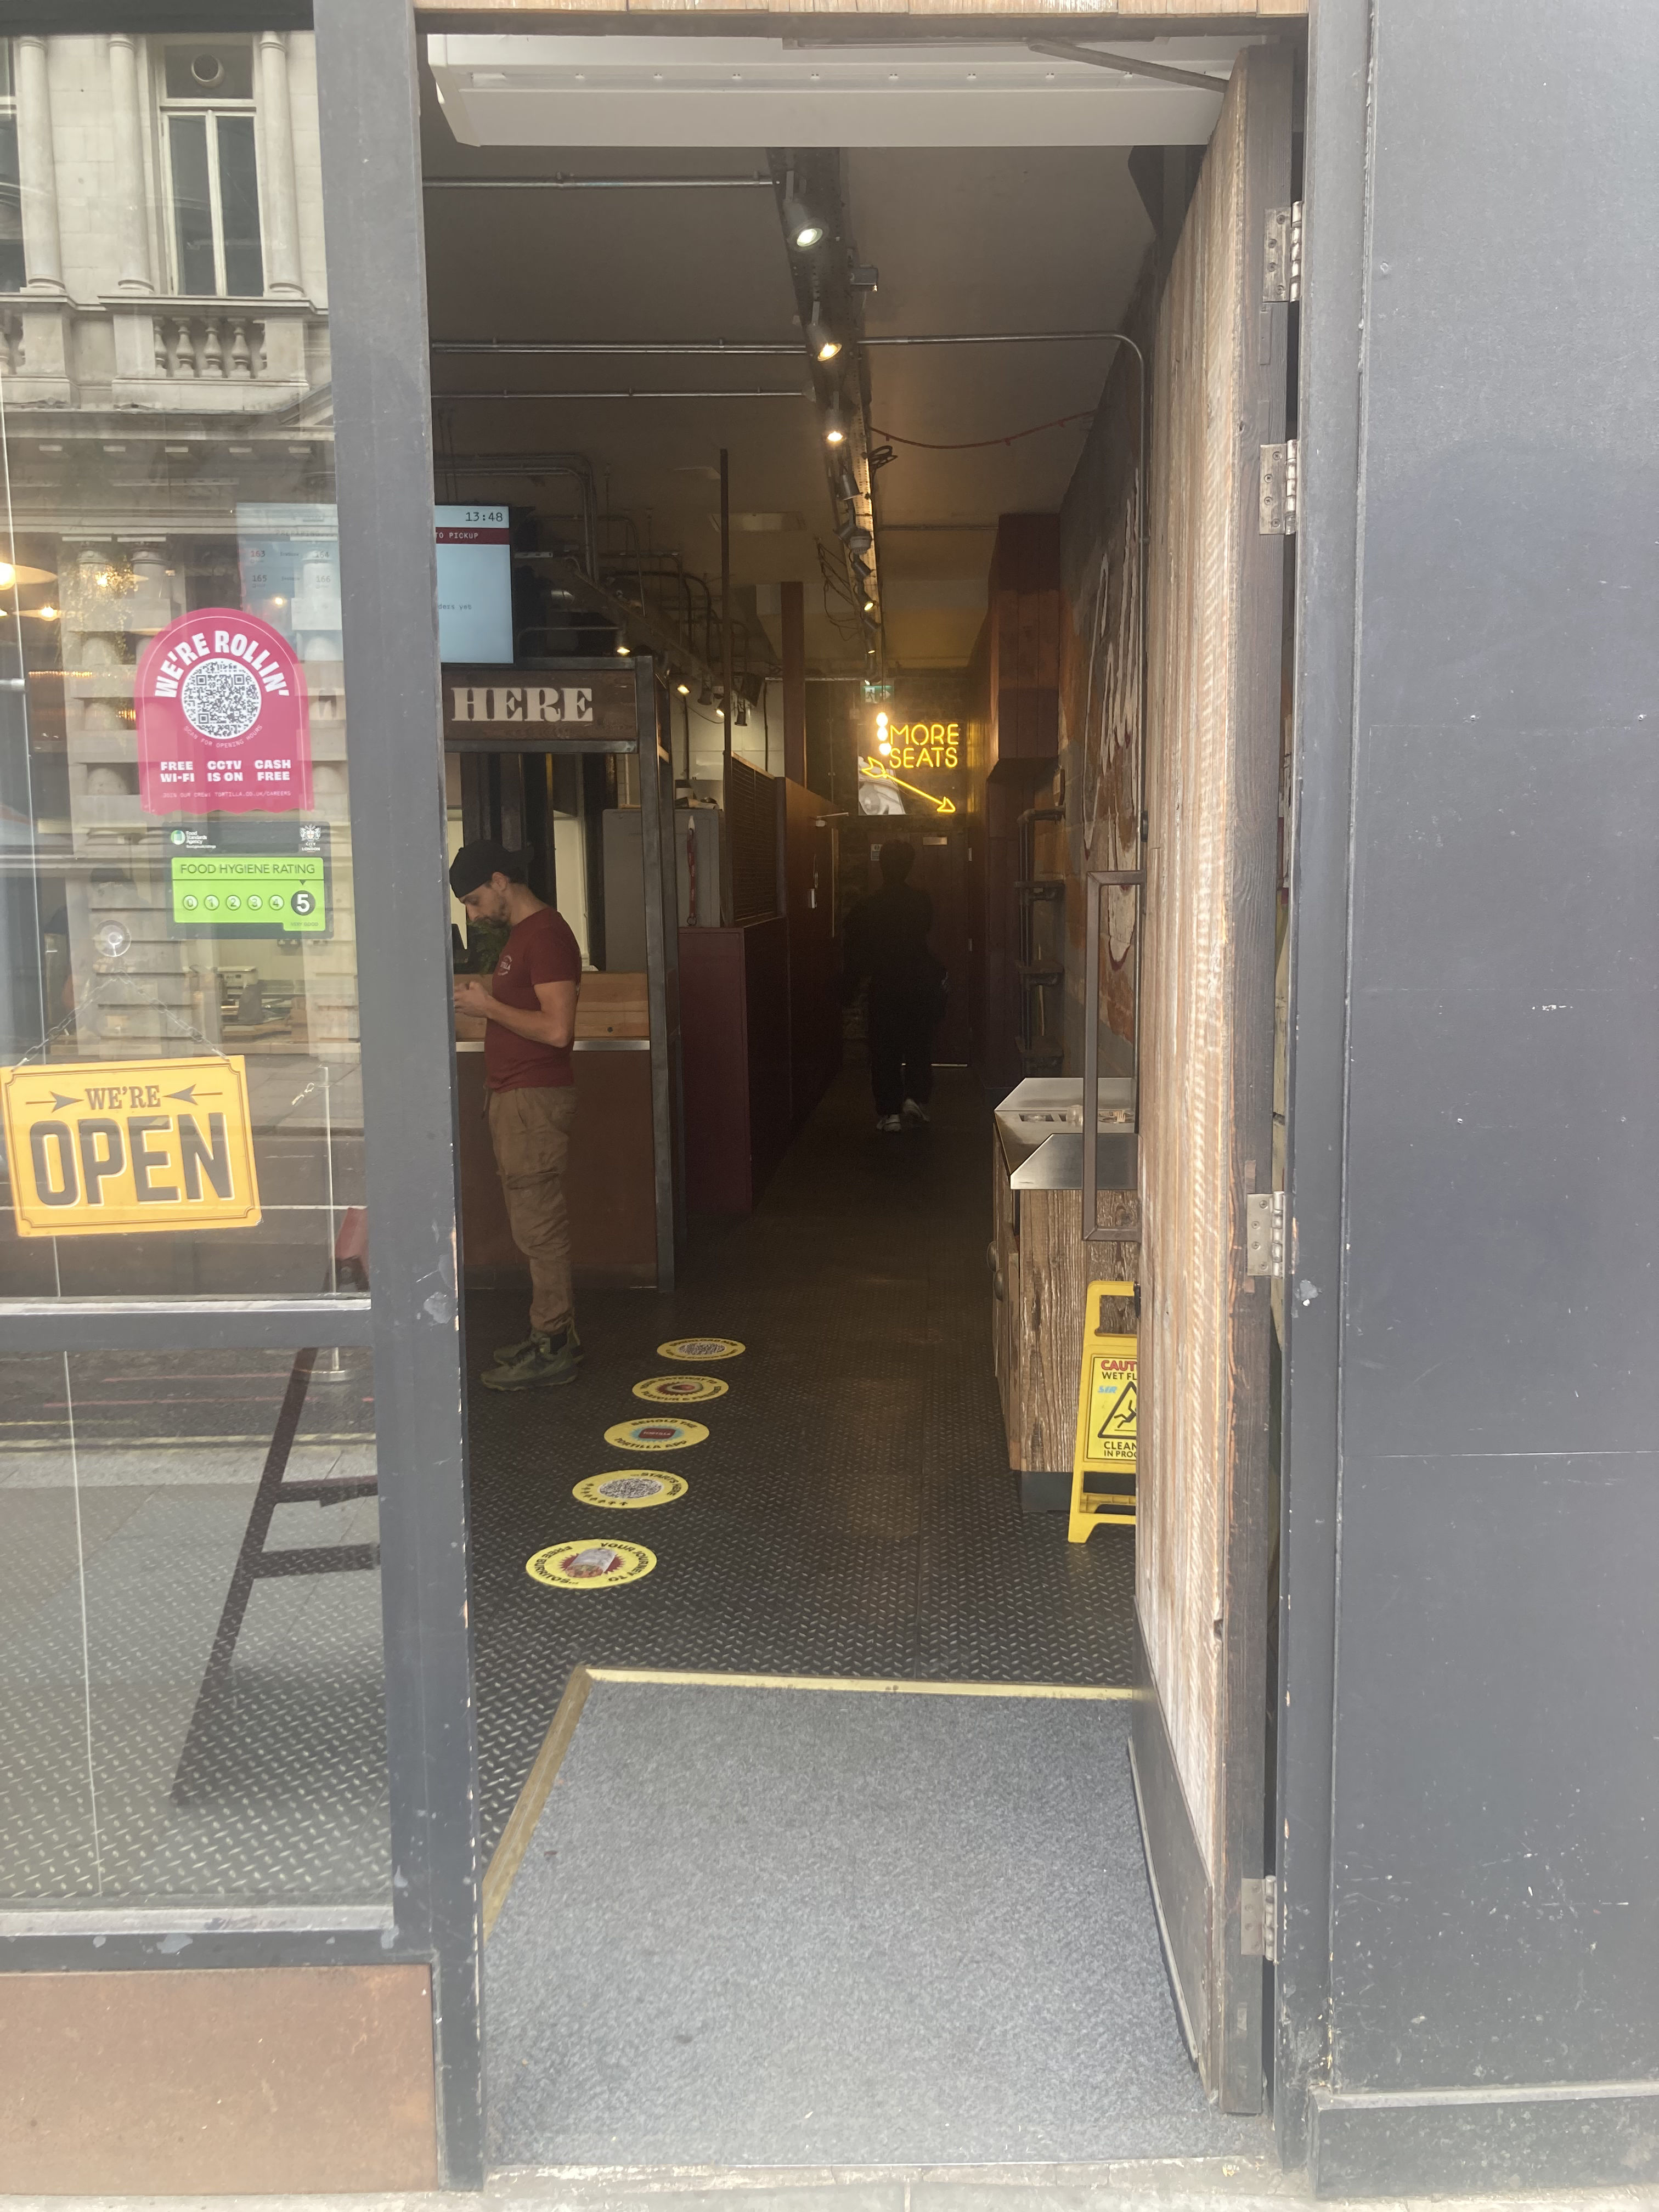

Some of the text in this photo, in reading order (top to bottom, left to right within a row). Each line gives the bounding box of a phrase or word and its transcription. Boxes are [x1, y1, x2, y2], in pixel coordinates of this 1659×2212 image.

[465, 512, 503, 522] 13:48
[154, 630, 290, 698] WE'RE ROLLIN'
[450, 687, 594, 723] HERE
[183, 724, 263, 748] SCAN FOR OPENING HOURS
[889, 723, 960, 746] MORE
[889, 746, 958, 769] SEATS
[161, 761, 194, 771] FREE
[207, 760, 242, 770] CCTV
[254, 759, 292, 770] CASH
[160, 772, 195, 783] WI-FI
[207, 772, 244, 782] IS ON
[257, 771, 290, 781] FREE
[180, 864, 315, 874] FOOD HYGIENE RATING
[187, 898, 194, 907] 0
[230, 898, 237, 907] 2
[251, 898, 258, 907] 3
[272, 898, 280, 907] 4
[296, 894, 311, 913] 5
[85, 1085, 161, 1110] WE'RE
[30, 1112, 235, 1208] OPEN
[1101, 1359, 1137, 1372] CAUT
[1102, 1372, 1124, 1380] WET
[641, 1391, 679, 1401] FLAVOUR
[614, 1437, 687, 1449] TORTILLA APP
[1104, 1441, 1137, 1451] CLEAN
[667, 1483, 682, 1496] HERE
[541, 1545, 573, 1559] FREE
[600, 1542, 636, 1551] YOUR
[627, 1550, 650, 1577] JOURNEY
